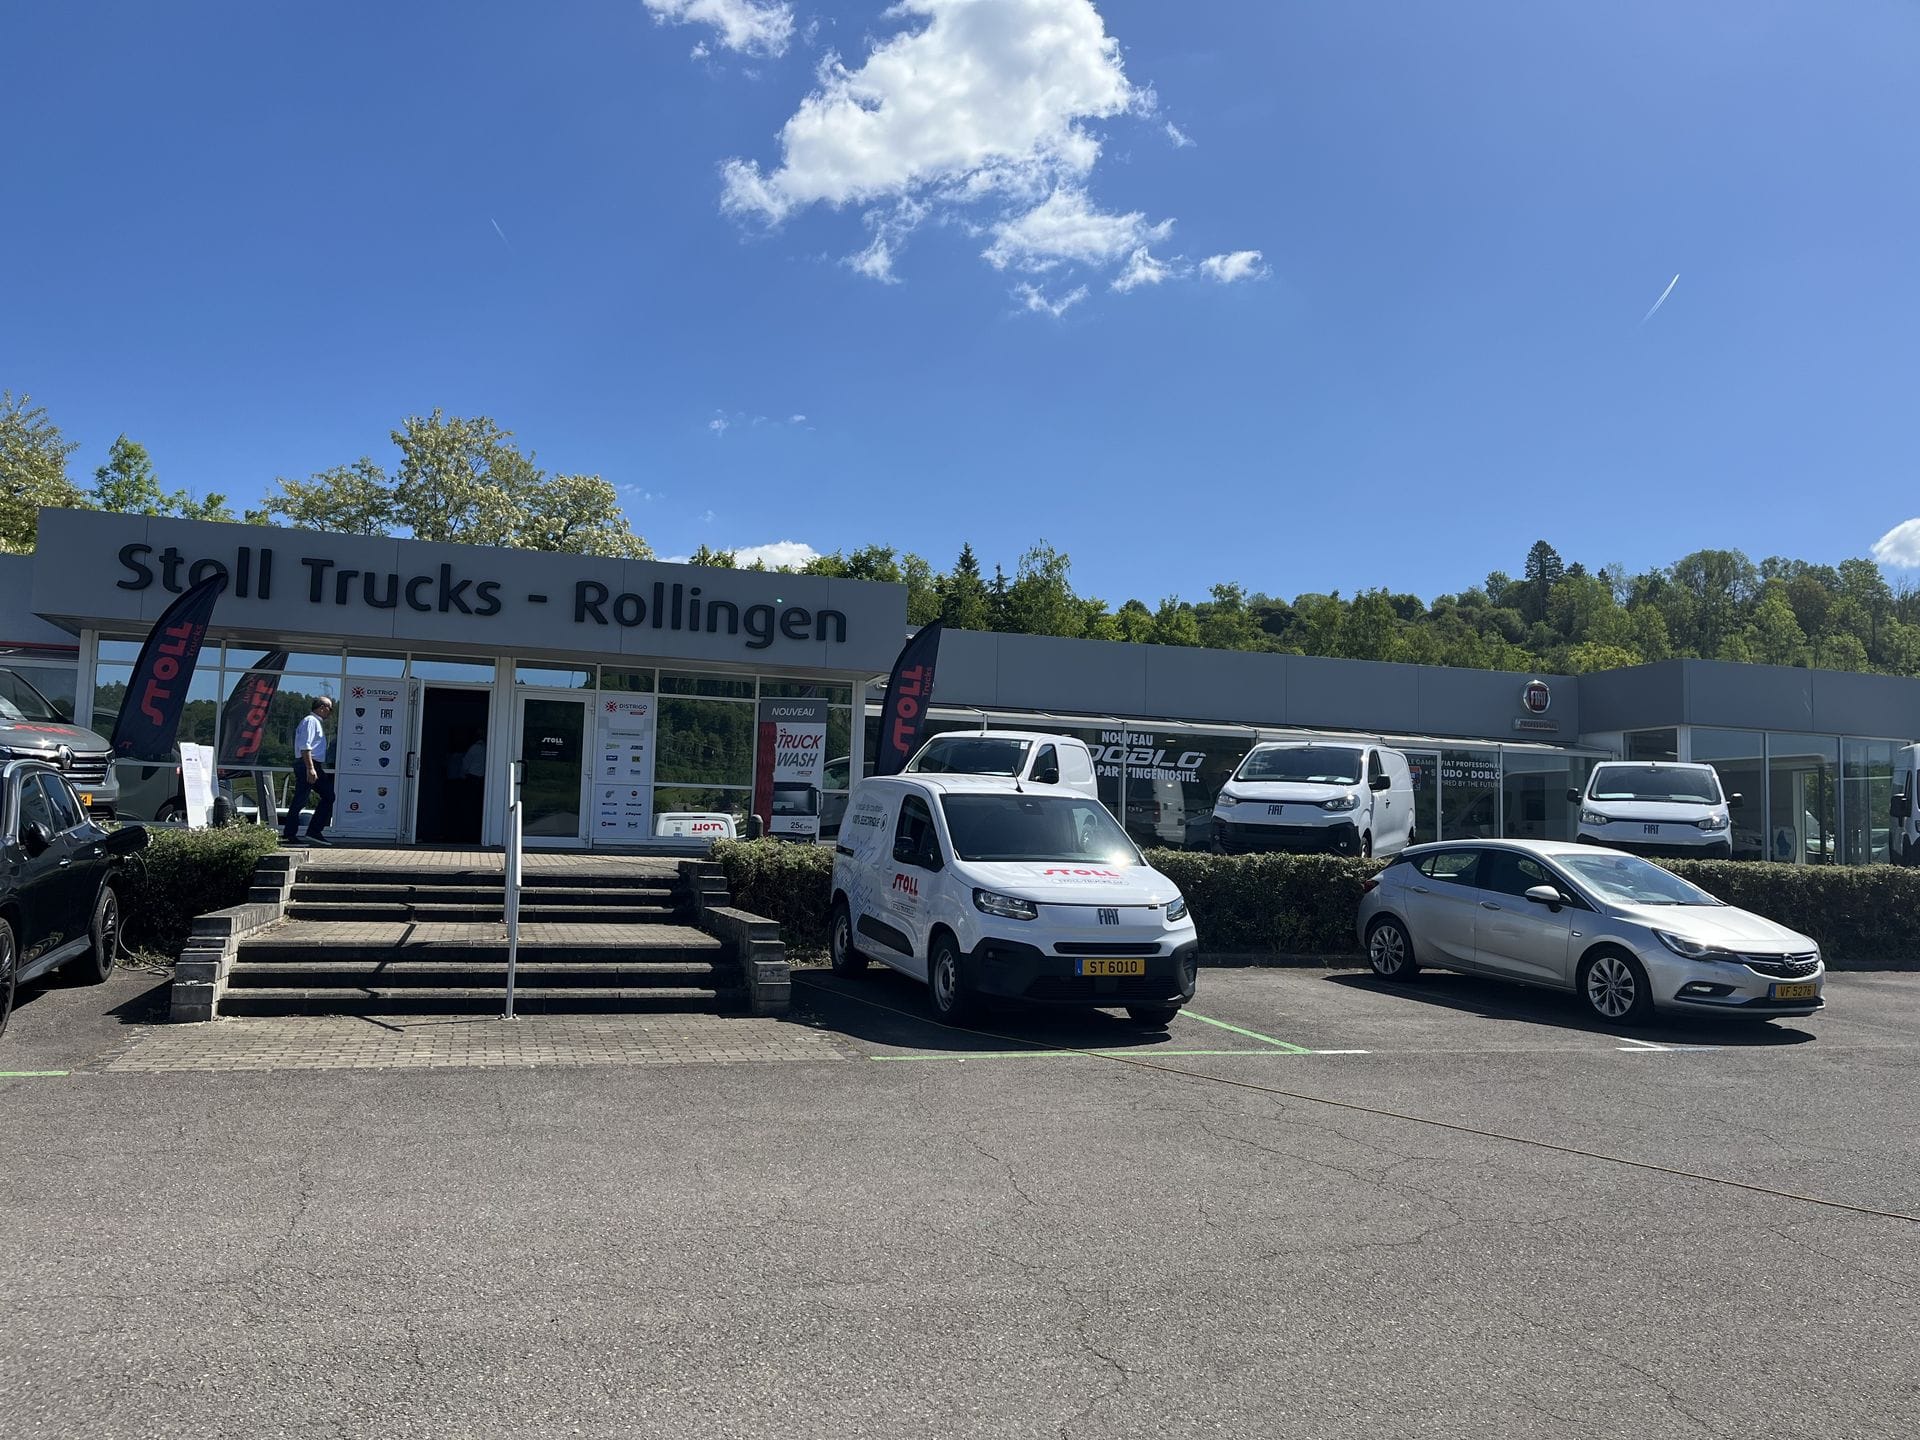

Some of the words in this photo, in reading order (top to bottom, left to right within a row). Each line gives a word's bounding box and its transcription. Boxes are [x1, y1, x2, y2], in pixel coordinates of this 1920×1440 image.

[116, 543, 273, 600] Stoll
[301, 557, 501, 616] Trucks
[528, 594, 548, 603] -
[574, 580, 847, 649] Rollingen
[140, 622, 193, 727] STOLL
[366, 689, 399, 697] DISTRIGO
[380, 708, 394, 719] FIAT
[771, 707, 816, 717] NOUVEAU
[892, 664, 924, 757] STOLL
[379, 725, 392, 735] FIAT
[777, 734, 824, 750] TRUCK
[1101, 731, 1154, 747] NOUVEAU
[776, 753, 819, 768] WASH
[1456, 761, 1500, 769] PROFESSIONA
[1097, 765, 1119, 777] PAR
[1124, 766, 1200, 783] 'INGÉNIOSITÉ.
[1431, 769, 1463, 778] SUDO
[1267, 804, 1284, 815] FIAT
[1643, 824, 1660, 834] FIAT
[1043, 869, 1120, 877] STOLL
[892, 873, 918, 897] STOLL
[1097, 908, 1120, 925] FIAT
[1090, 961, 1105, 973] ST
[1108, 961, 1138, 974] 6010
[1780, 986, 1791, 997] VF
